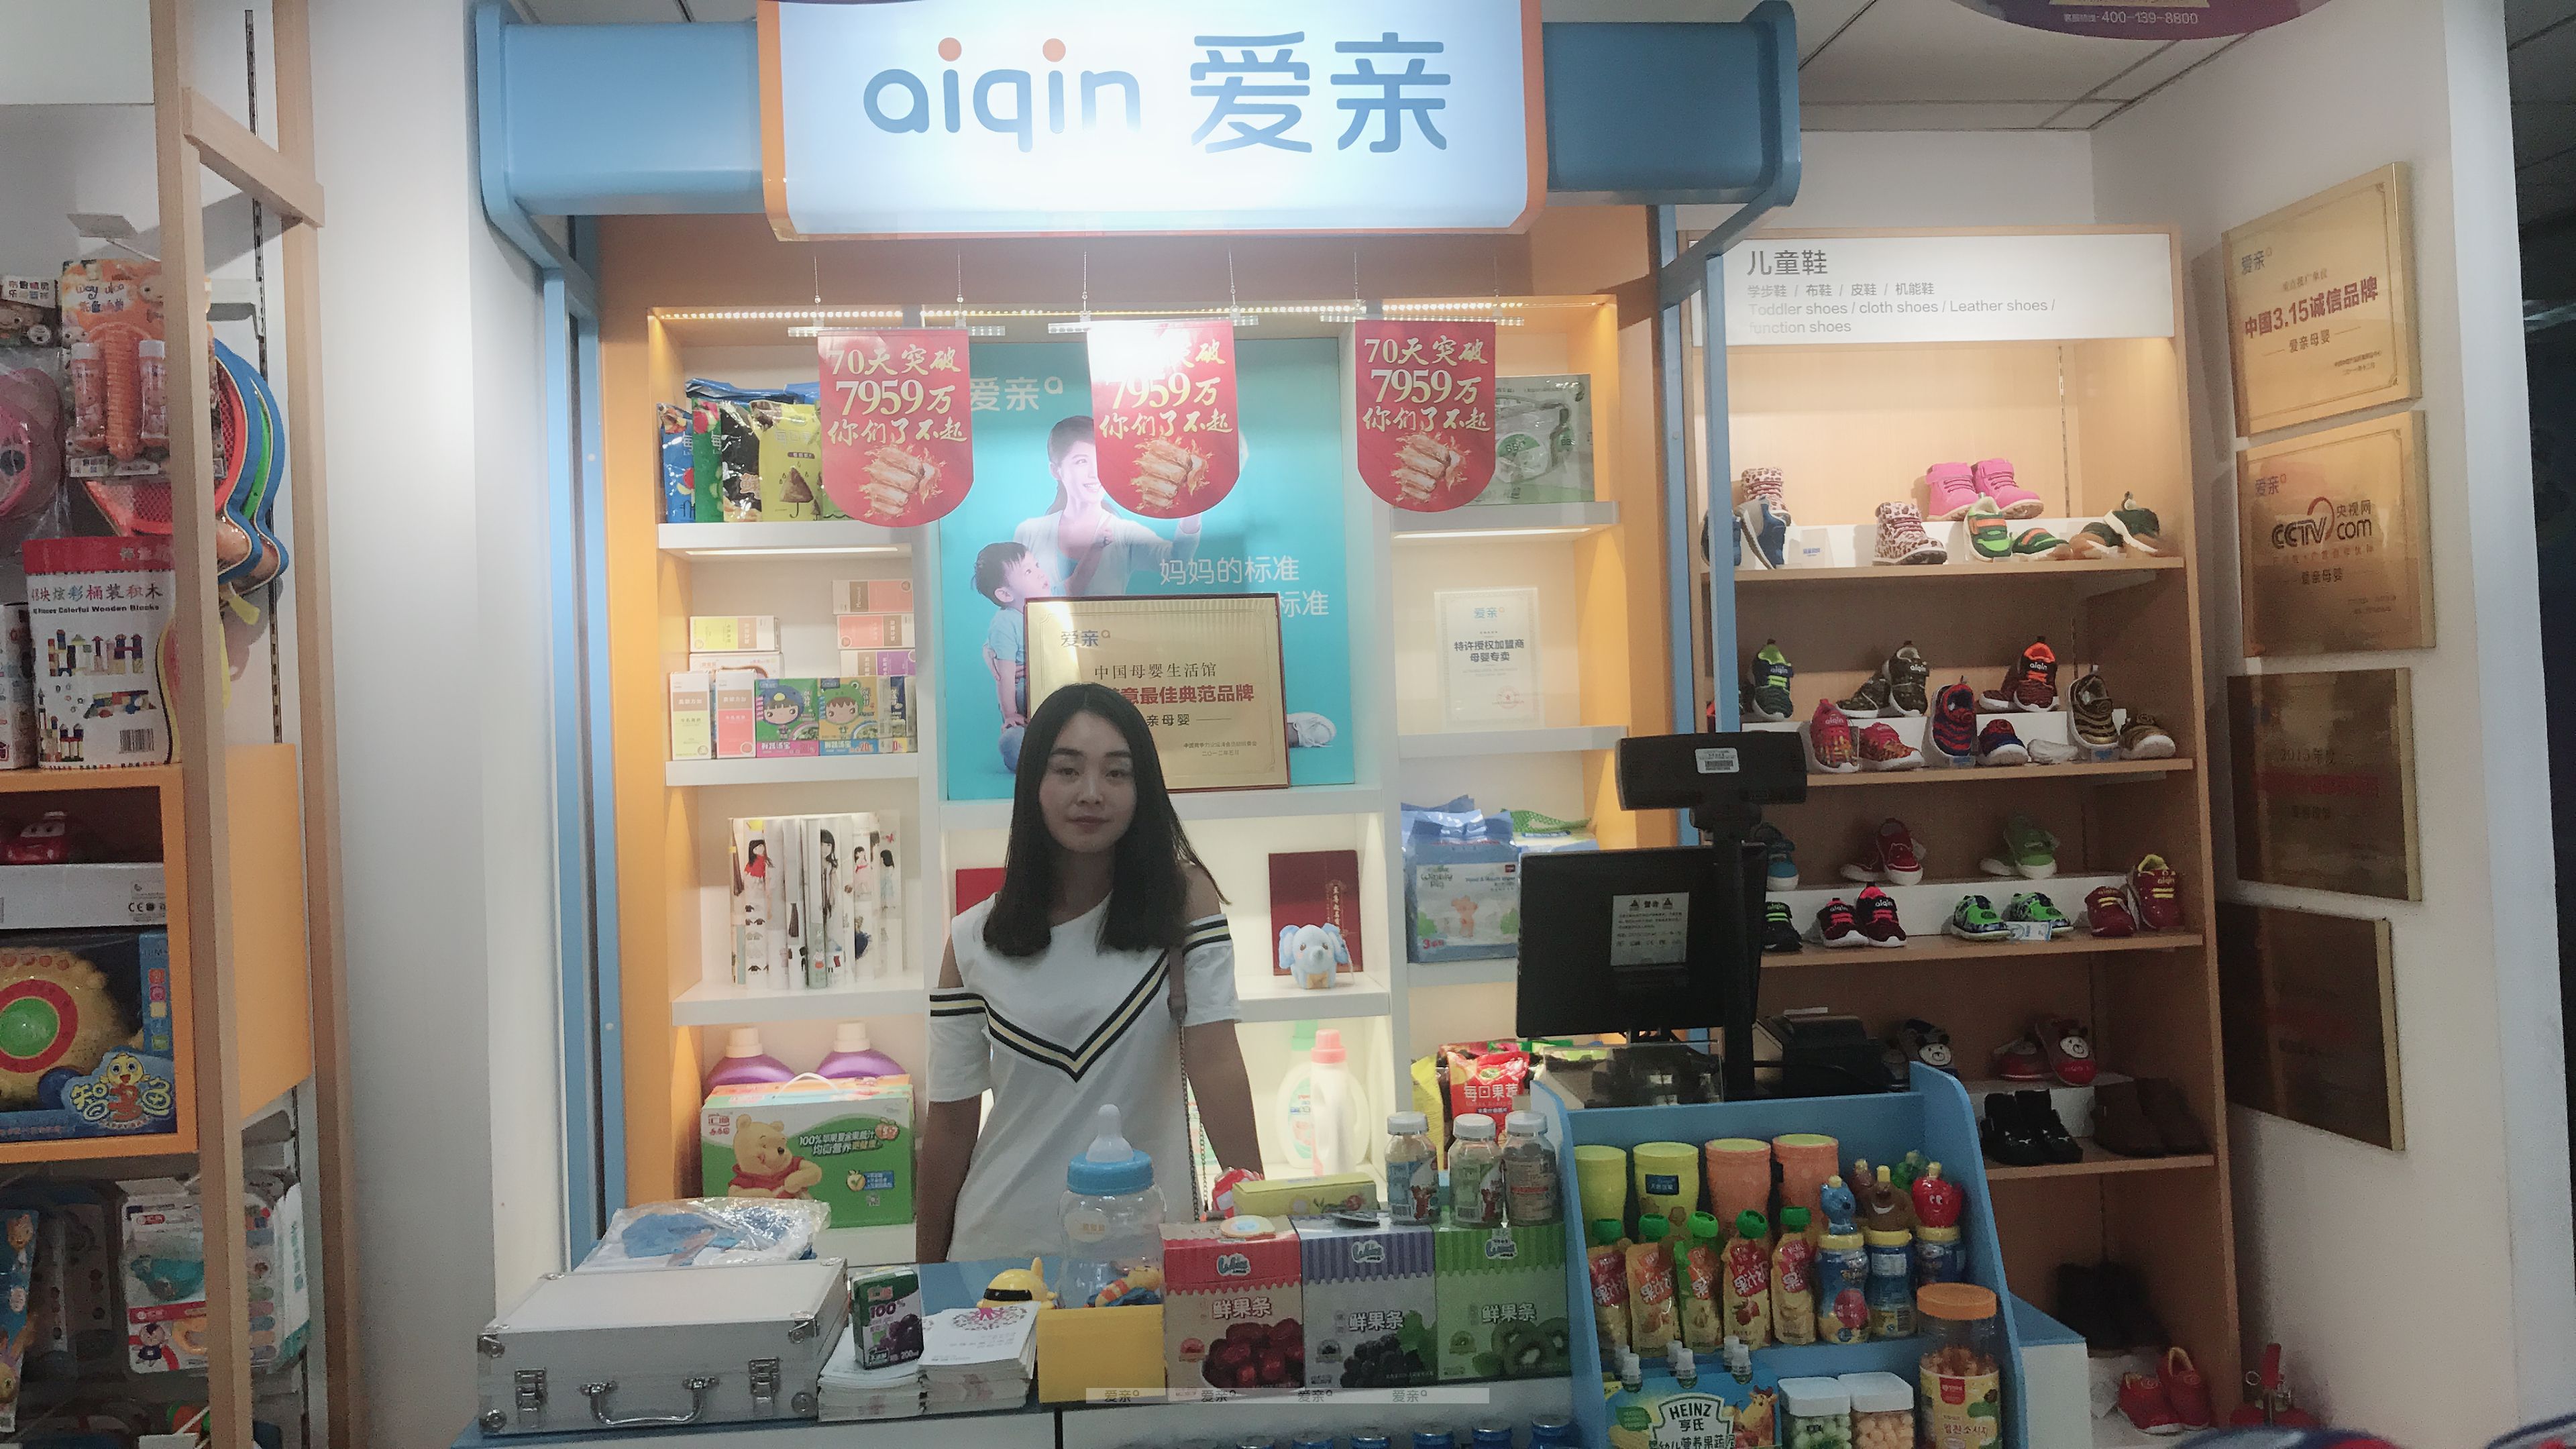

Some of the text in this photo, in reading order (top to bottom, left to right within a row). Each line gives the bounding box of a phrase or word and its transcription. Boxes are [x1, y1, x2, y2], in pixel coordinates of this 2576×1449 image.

[2101, 11, 2198, 24] 400-139-8800
[863, 32, 1451, 153] aiqin 爱亲
[1747, 250, 1828, 276] 儿童鞋
[1747, 284, 1787, 299] 学步鞋
[1805, 284, 1833, 297] 布鞋
[1850, 282, 1877, 297] 皮鞋
[1895, 282, 1935, 297] 机能鞋
[1748, 302, 1802, 315] Toddler
[1805, 302, 1848, 315] shoes
[1859, 300, 1894, 314] cloth
[1897, 301, 1939, 313] shoes
[1950, 299, 2003, 313] Leather
[2006, 299, 2048, 311] shoes
[1749, 320, 1851, 335] function shoes
[1364, 335, 1488, 366] 70天突破
[836, 378, 956, 415] 7959万
[1371, 368, 1482, 404] 7959万
[1099, 407, 1233, 439] 你们了不起
[1362, 406, 1491, 432] 你们了不起
[827, 416, 968, 446] 你们了不起
[2337, 499, 2371, 519] 央视网
[2271, 516, 2372, 549] CCTV com
[1159, 555, 1299, 586] 妈妈的标准
[1454, 639, 1525, 651] 特许授权加盟商
[1470, 651, 1510, 662] 母婴专卖
[2029, 661, 2048, 670] aiqin
[1094, 661, 1218, 680] 中国母婴生活馆
[1112, 684, 1254, 705] 意最佳典范品牌
[1212, 1296, 1272, 1319] 鲜果条
[1481, 1303, 1538, 1324] 鲜果条
[1348, 1310, 1405, 1333] 鲜果条
[1669, 1403, 1712, 1420] HEINZ
[1679, 1418, 1705, 1432] 亨氏
